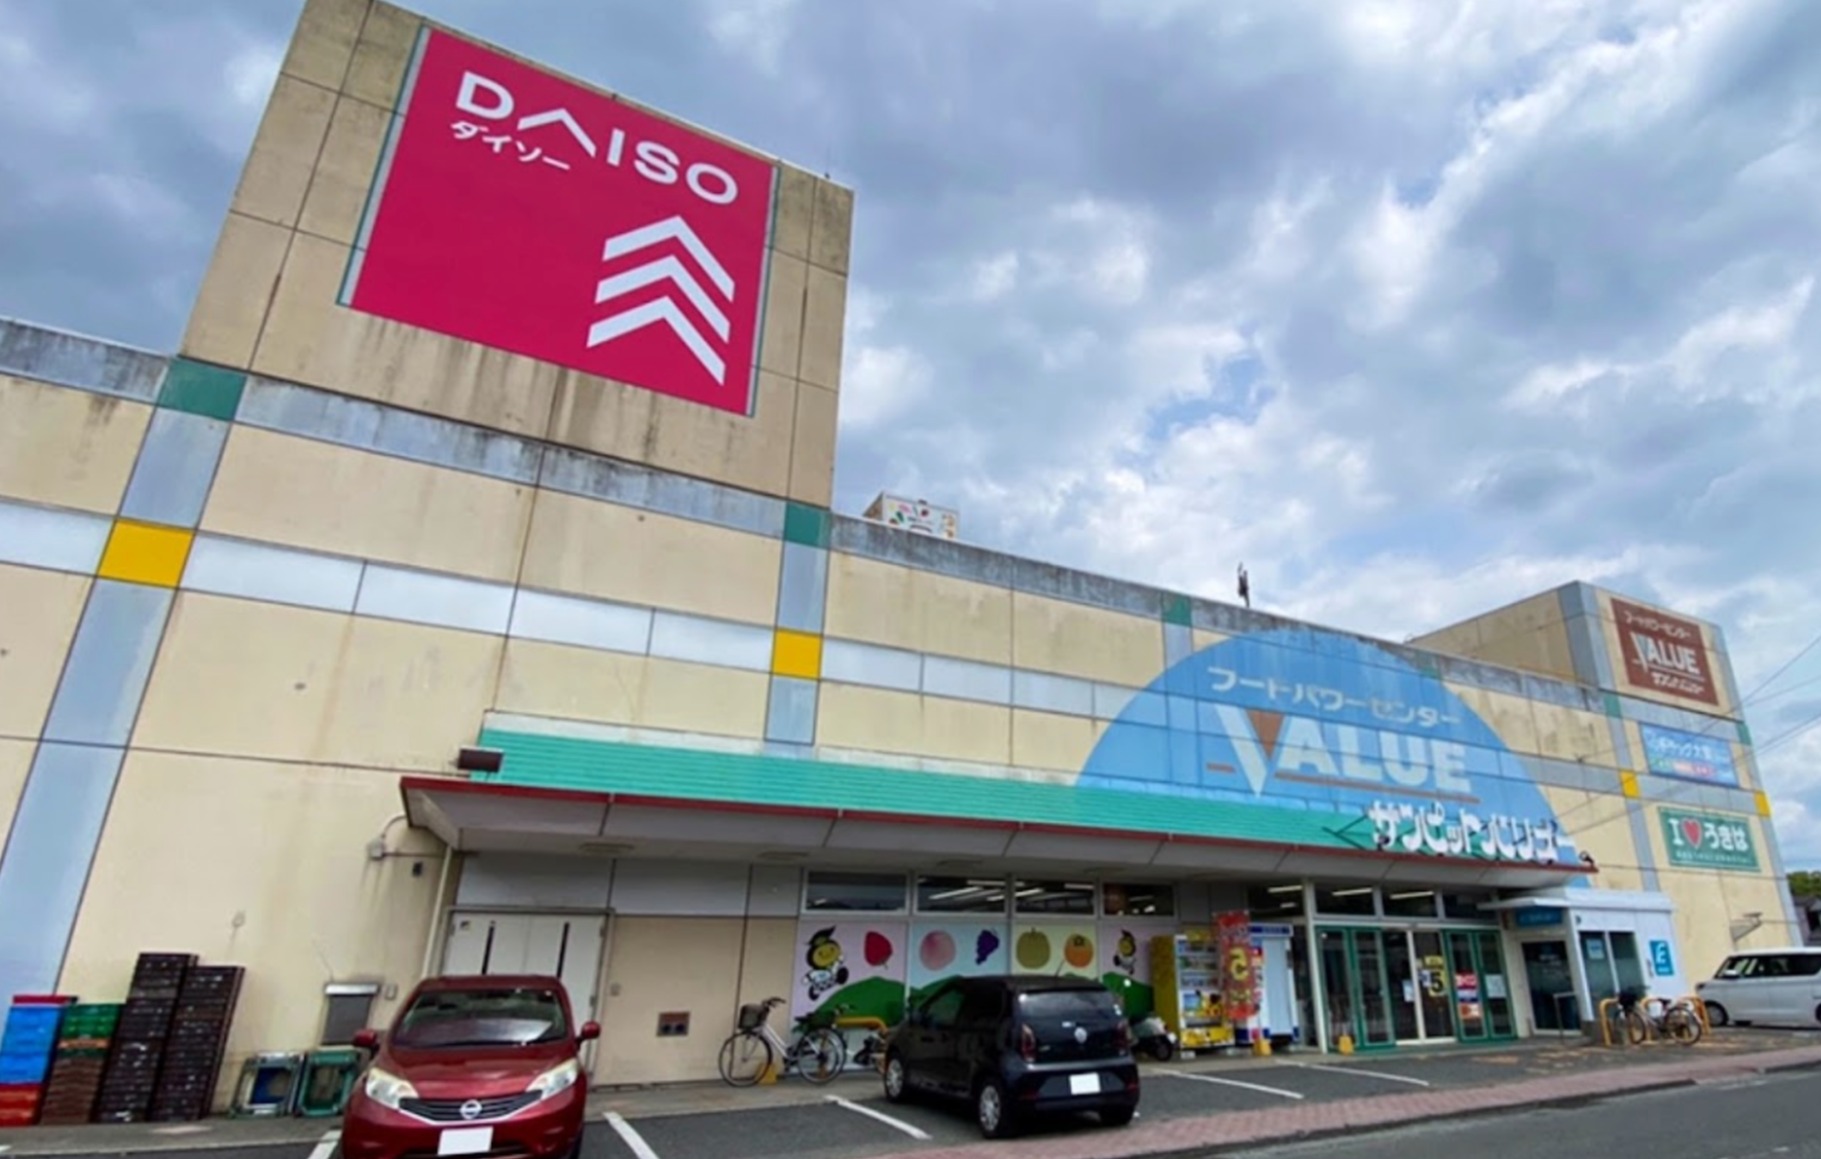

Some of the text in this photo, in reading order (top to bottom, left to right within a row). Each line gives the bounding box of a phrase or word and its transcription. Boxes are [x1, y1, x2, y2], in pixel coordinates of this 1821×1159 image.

[451, 120, 570, 170] ダイソー
[456, 70, 738, 204] DAISO
[1629, 631, 1700, 674] VALUE
[1214, 703, 1472, 799] VALUE
